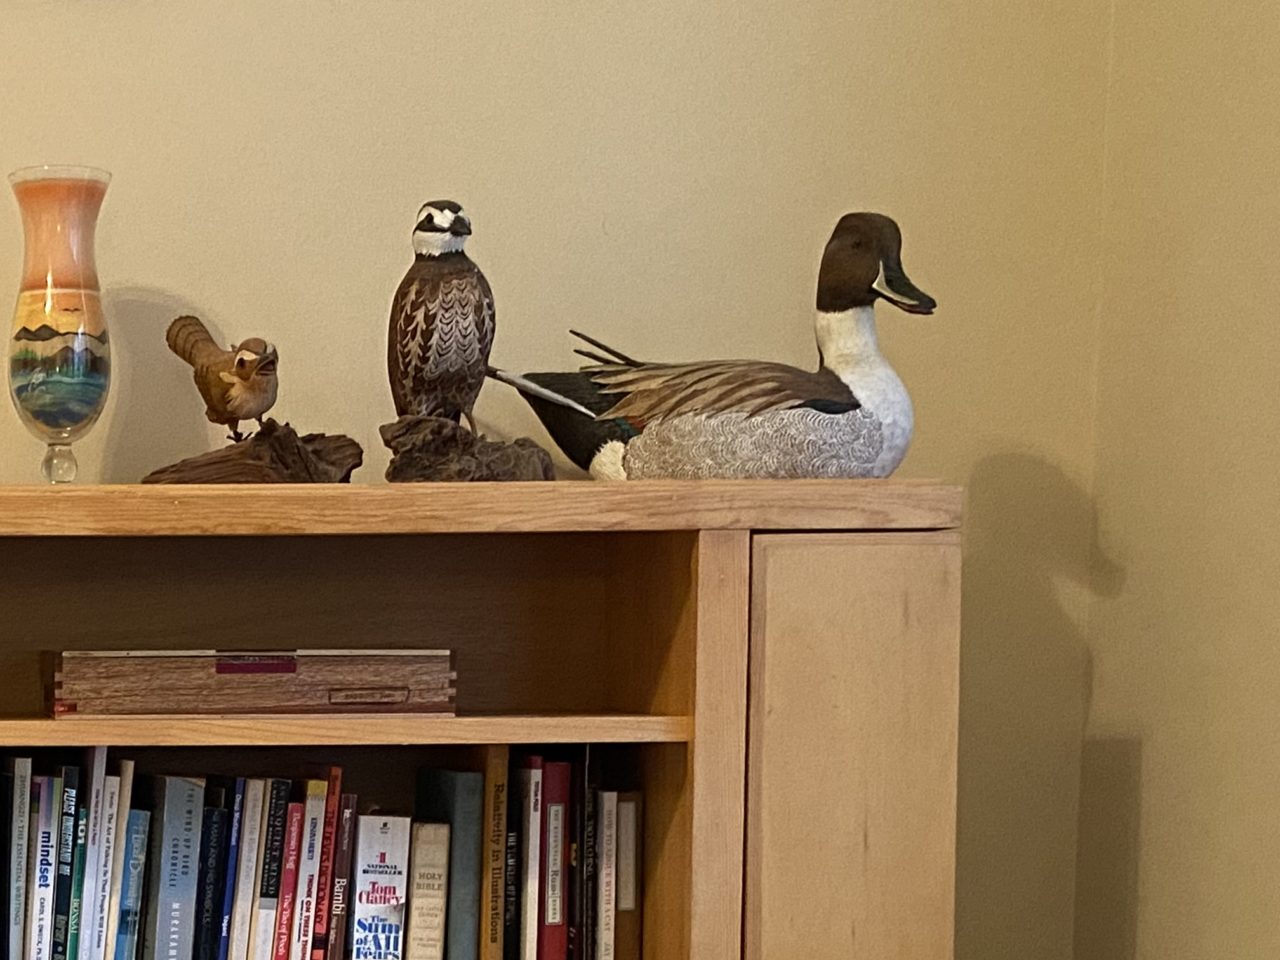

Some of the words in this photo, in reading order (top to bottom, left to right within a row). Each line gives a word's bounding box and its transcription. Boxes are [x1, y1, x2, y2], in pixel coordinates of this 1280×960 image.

[17, 775, 27, 817] ZHUANGZI
[62, 788, 76, 815] PLEASE
[185, 788, 194, 803] THE
[107, 813, 115, 825] The
[326, 809, 336, 830] THE
[490, 782, 506, 846] Relativity
[605, 809, 613, 830] HOW
[17, 824, 25, 840] THE
[77, 816, 87, 845] 101
[209, 823, 219, 847] MAN
[272, 800, 285, 857] UNQUIET
[288, 812, 301, 850] Benjamin
[60, 815, 75, 864] UNDERSTAND
[322, 830, 334, 863] DEVIL'S
[605, 833, 613, 846] TO
[15, 843, 24, 884] ESSENTIAL
[39, 831, 54, 889] mindset
[103, 845, 112, 868] Talking
[168, 837, 180, 888] CHRONICLE
[181, 854, 190, 876] BIRD
[207, 846, 217, 868] AND
[286, 850, 297, 870] Hoff
[490, 849, 504, 863] in
[605, 847, 613, 878] ARGUE
[59, 863, 71, 877] ME
[103, 869, 109, 878] So
[206, 868, 215, 884] HIS
[268, 862, 278, 895] MIND
[418, 871, 443, 881] HOLY
[101, 878, 109, 893] That
[305, 873, 315, 899] THINK
[368, 881, 397, 896] Tom
[415, 882, 443, 892] BIBLE
[549, 869, 561, 896] Rumi
[604, 878, 613, 905] WITH
[99, 894, 107, 915] People
[283, 893, 293, 909] The
[315, 864, 330, 925] DICTIONARY
[332, 878, 348, 915] Bambi
[358, 890, 403, 908] Clancy
[13, 886, 22, 926] WRITINGS
[202, 885, 214, 926] SYMBOLS
[304, 900, 312, 913] ON
[488, 867, 504, 944] Illustrations
[71, 898, 80, 935] BONSAI
[98, 916, 106, 929] Will
[282, 909, 291, 924] Tao
[302, 914, 311, 938] THESE
[356, 918, 401, 934] Sum
[370, 915, 388, 923] The
[604, 914, 612, 932] CAT
[279, 924, 289, 933] of
[96, 930, 105, 949] Listen
[277, 934, 288, 957] Pooh
[355, 934, 369, 947] of
[368, 934, 400, 952] All
[603, 941, 611, 959] JAY
[354, 946, 401, 960] Fears
